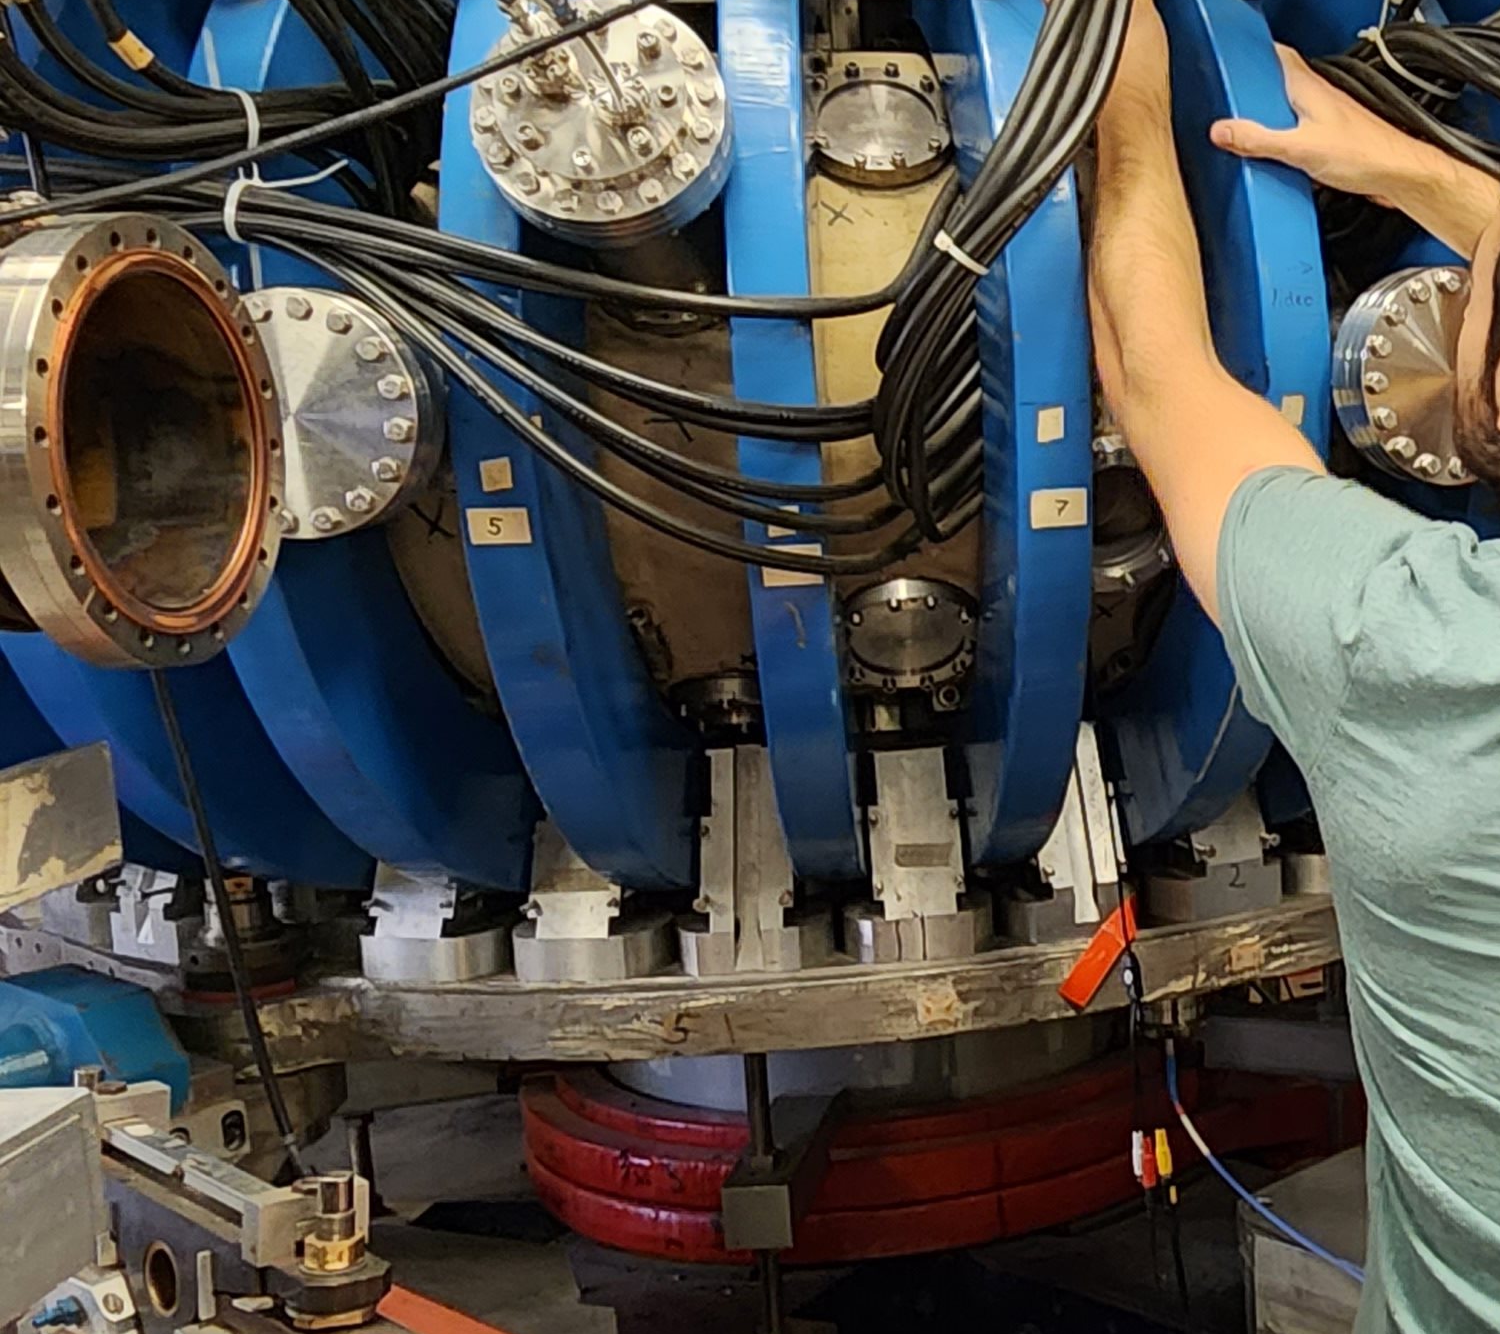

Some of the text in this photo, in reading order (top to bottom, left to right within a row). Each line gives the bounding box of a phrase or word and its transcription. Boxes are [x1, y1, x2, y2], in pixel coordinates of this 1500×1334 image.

[1055, 498, 1069, 517] 7
[487, 516, 503, 536] 5
[1228, 863, 1246, 888] 2
